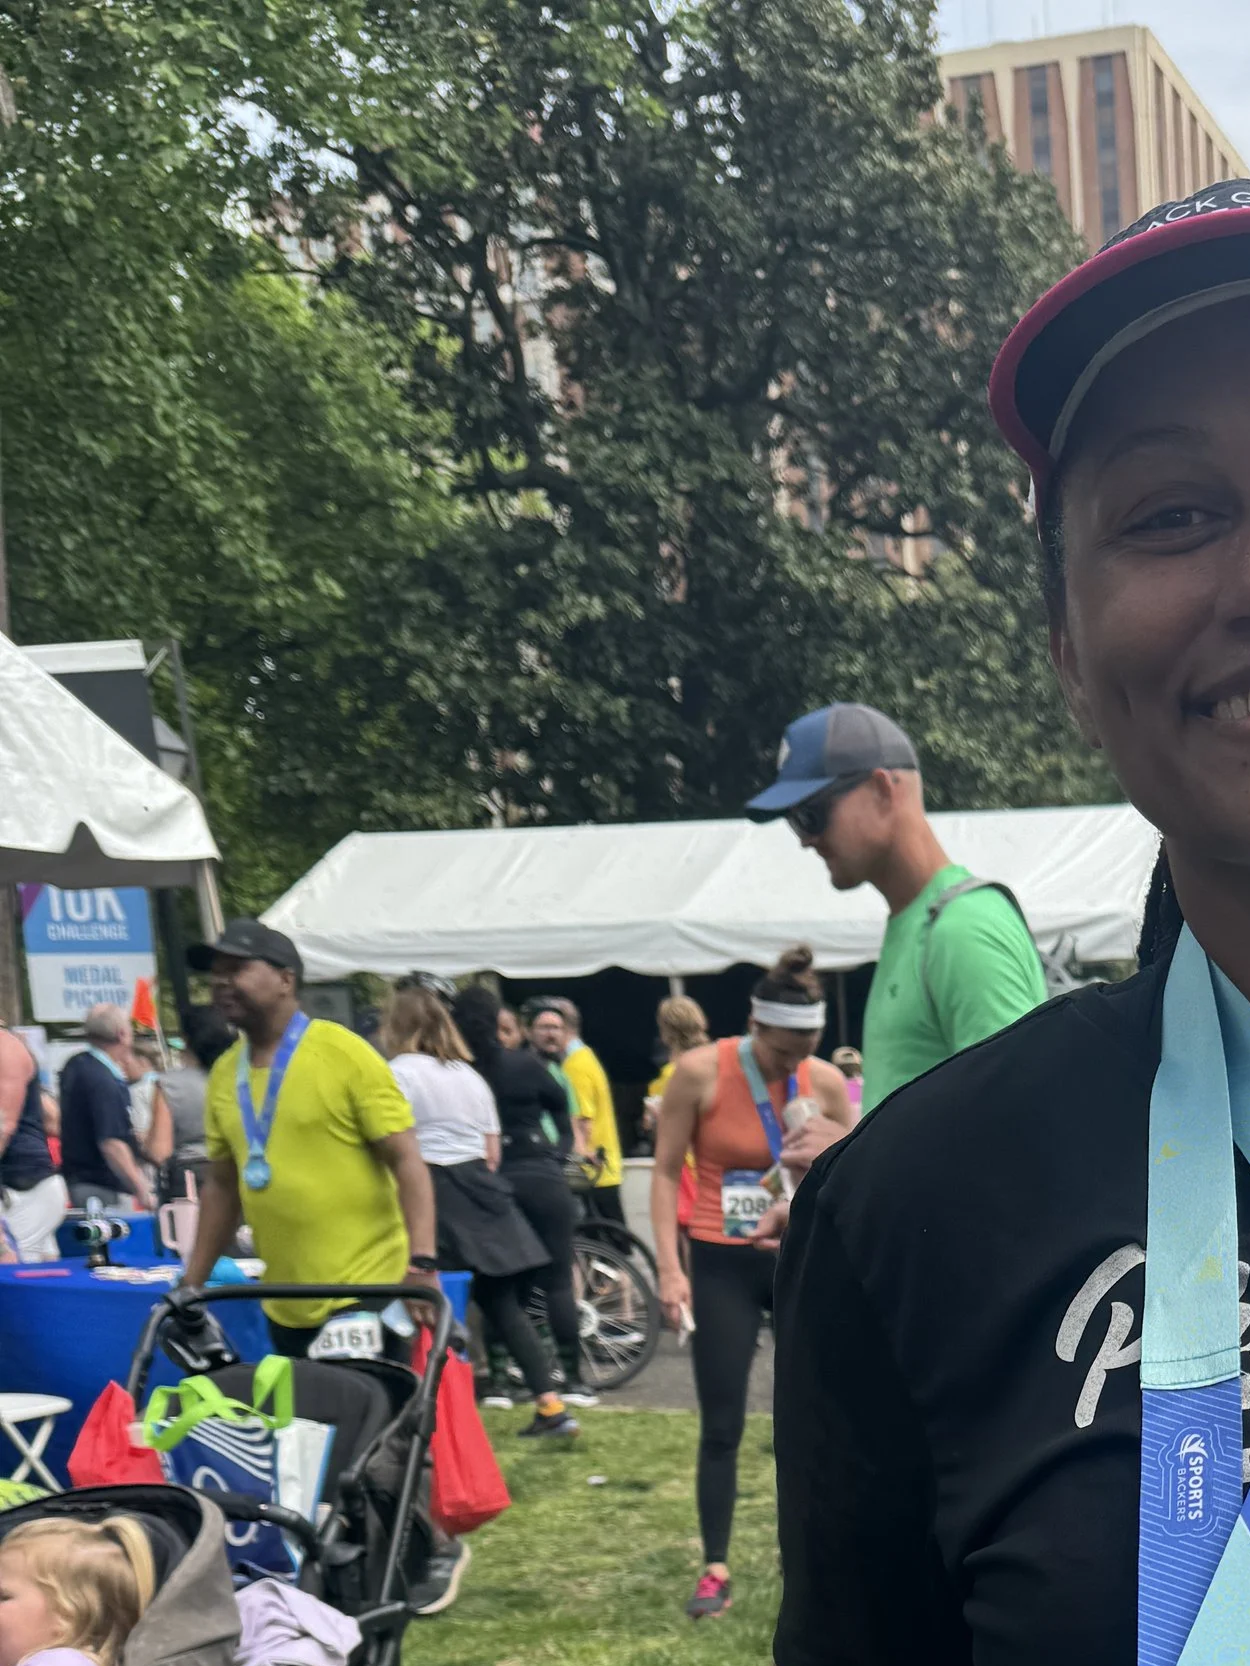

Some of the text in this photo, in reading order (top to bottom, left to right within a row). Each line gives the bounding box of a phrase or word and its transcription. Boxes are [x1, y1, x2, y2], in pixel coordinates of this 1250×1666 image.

[1147, 196, 1218, 232] ACK
[47, 923, 130, 942] CHALLENGE
[63, 965, 124, 986] MEDAL
[1176, 1467, 1187, 1523] BACKERS
[1188, 1456, 1204, 1521] SPORTS
